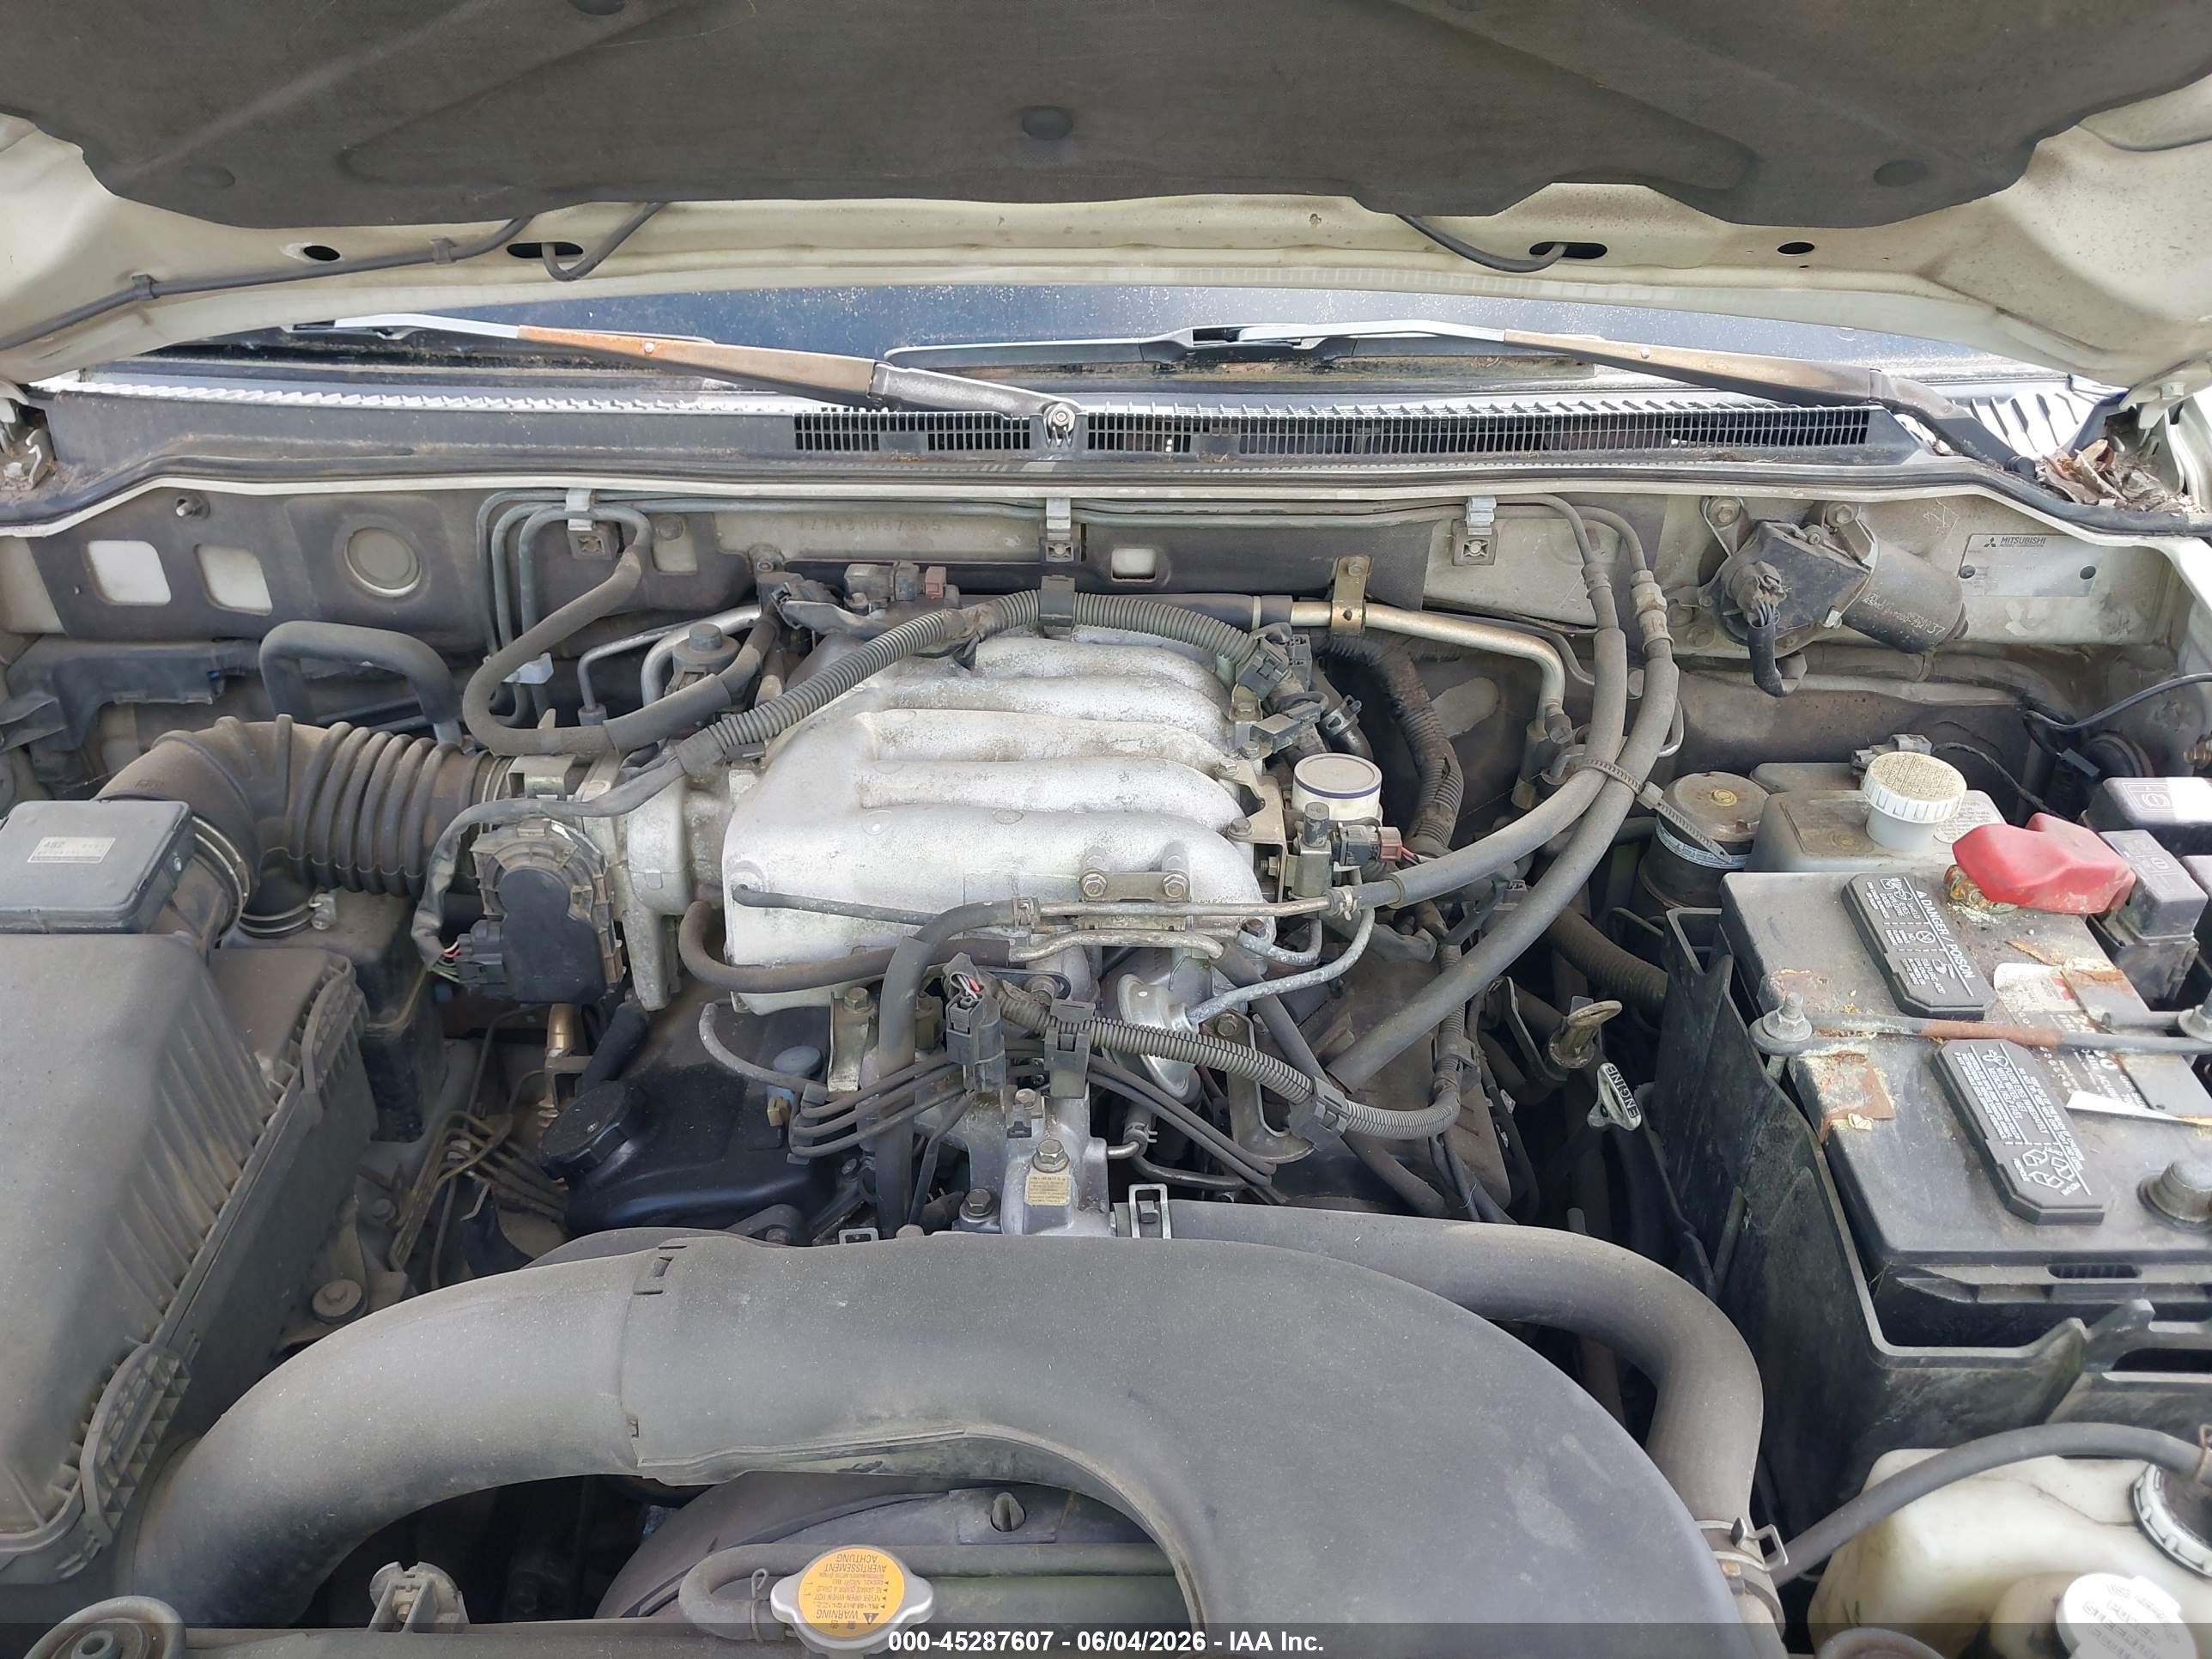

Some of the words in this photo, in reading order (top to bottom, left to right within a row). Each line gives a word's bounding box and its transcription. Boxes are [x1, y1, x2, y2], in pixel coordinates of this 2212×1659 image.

[2000, 536, 2047, 544] MITSUBISHI
[1919, 899, 1951, 934] DANGER
[1945, 944, 1976, 978] POISON
[1606, 1066, 1638, 1118] ENGINE
[2002, 1066, 2020, 1084] FLUSH
[2013, 1084, 2028, 1097] EYES
[2021, 1098, 2050, 1133] IMMEDIATELY
[836, 1553, 878, 1563] ACHTUNG
[824, 1563, 886, 1572] AVERTISSEMENT
[816, 1609, 859, 1620] WARNING
